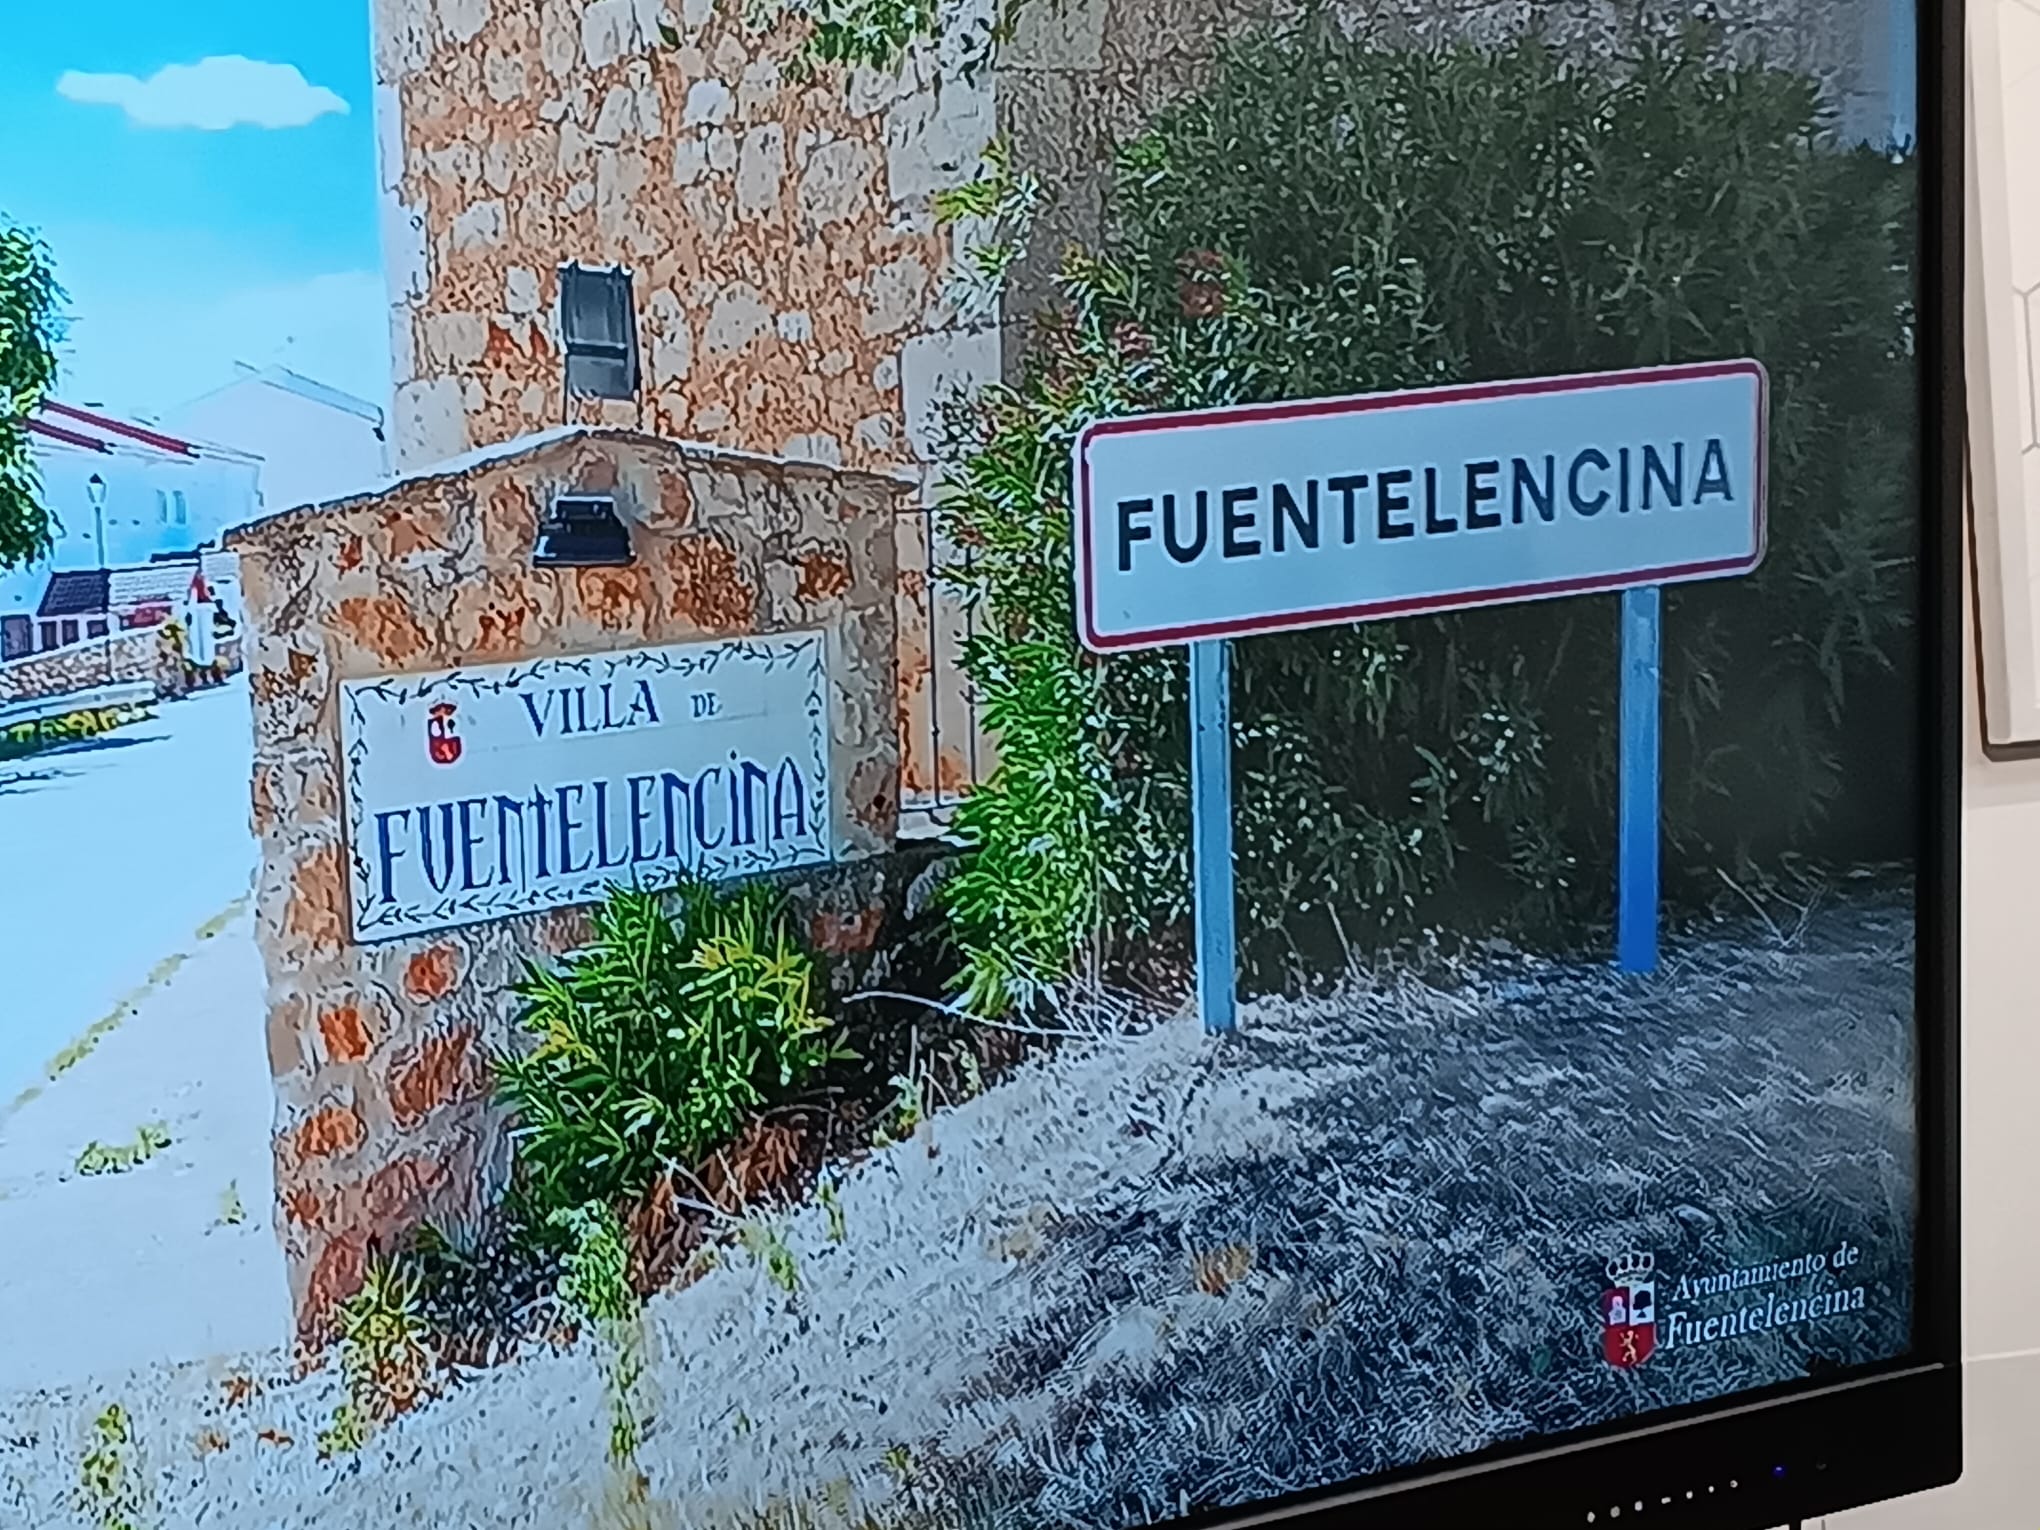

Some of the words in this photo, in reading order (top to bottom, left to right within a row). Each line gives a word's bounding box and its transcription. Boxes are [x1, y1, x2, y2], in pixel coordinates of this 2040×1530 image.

[1116, 437, 1735, 572] FUENTELENCINA
[518, 679, 660, 737] VILLA
[690, 692, 722, 719] DE
[1671, 1252, 1826, 1304] Ayuntamiento
[1832, 1240, 1860, 1268] de
[1665, 1285, 1866, 1350] Fuentelencina
